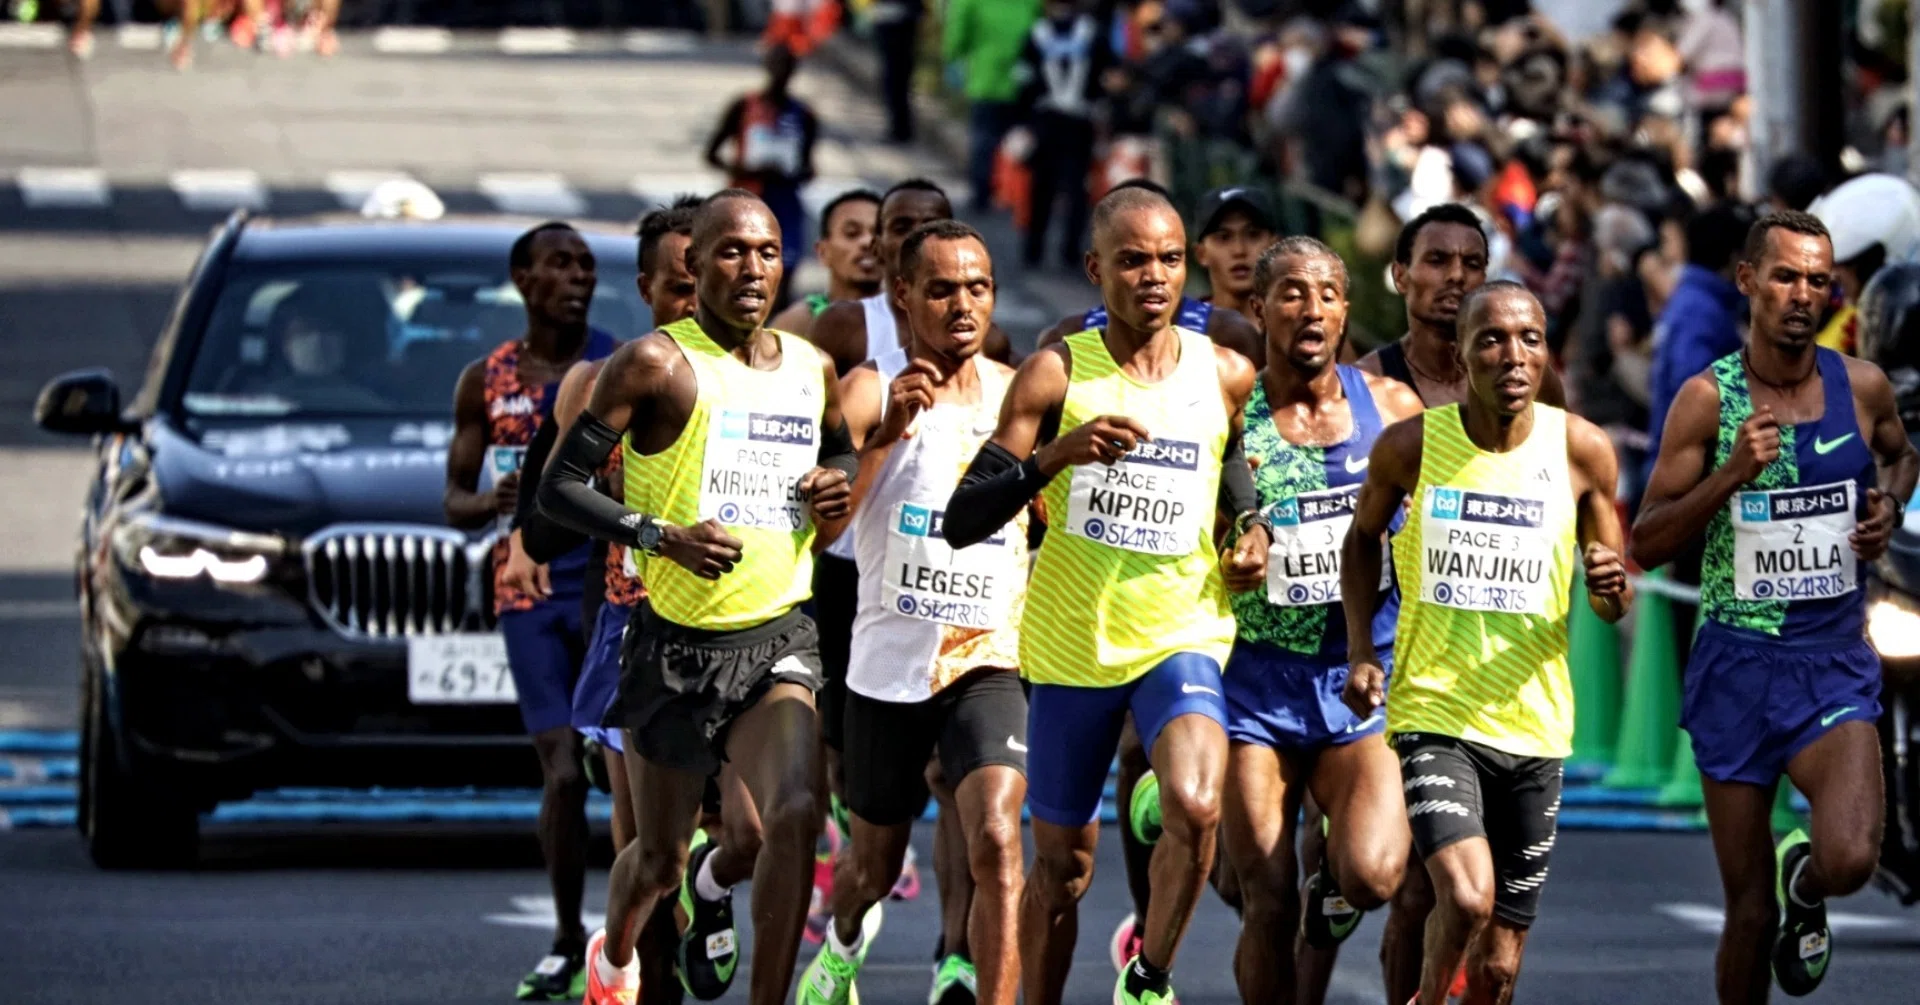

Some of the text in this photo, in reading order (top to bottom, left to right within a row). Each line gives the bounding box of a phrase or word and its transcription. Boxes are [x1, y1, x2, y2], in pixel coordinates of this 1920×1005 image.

[737, 449, 782, 467] PACE
[709, 469, 769, 498] KIRWA
[1105, 468, 1157, 491] PACE
[1088, 487, 1184, 525] KIPROP
[1465, 499, 1541, 523] 東京メトロ
[1775, 492, 1845, 514] 東京メトロ
[1322, 524, 1335, 545] 3
[1448, 528, 1520, 551] PACE 3
[1792, 523, 1804, 545] 2
[1283, 549, 1342, 578] LEM
[1428, 547, 1542, 584] WANJIKU
[1755, 544, 1842, 574] MOLLA
[900, 562, 994, 600] LEGESE
